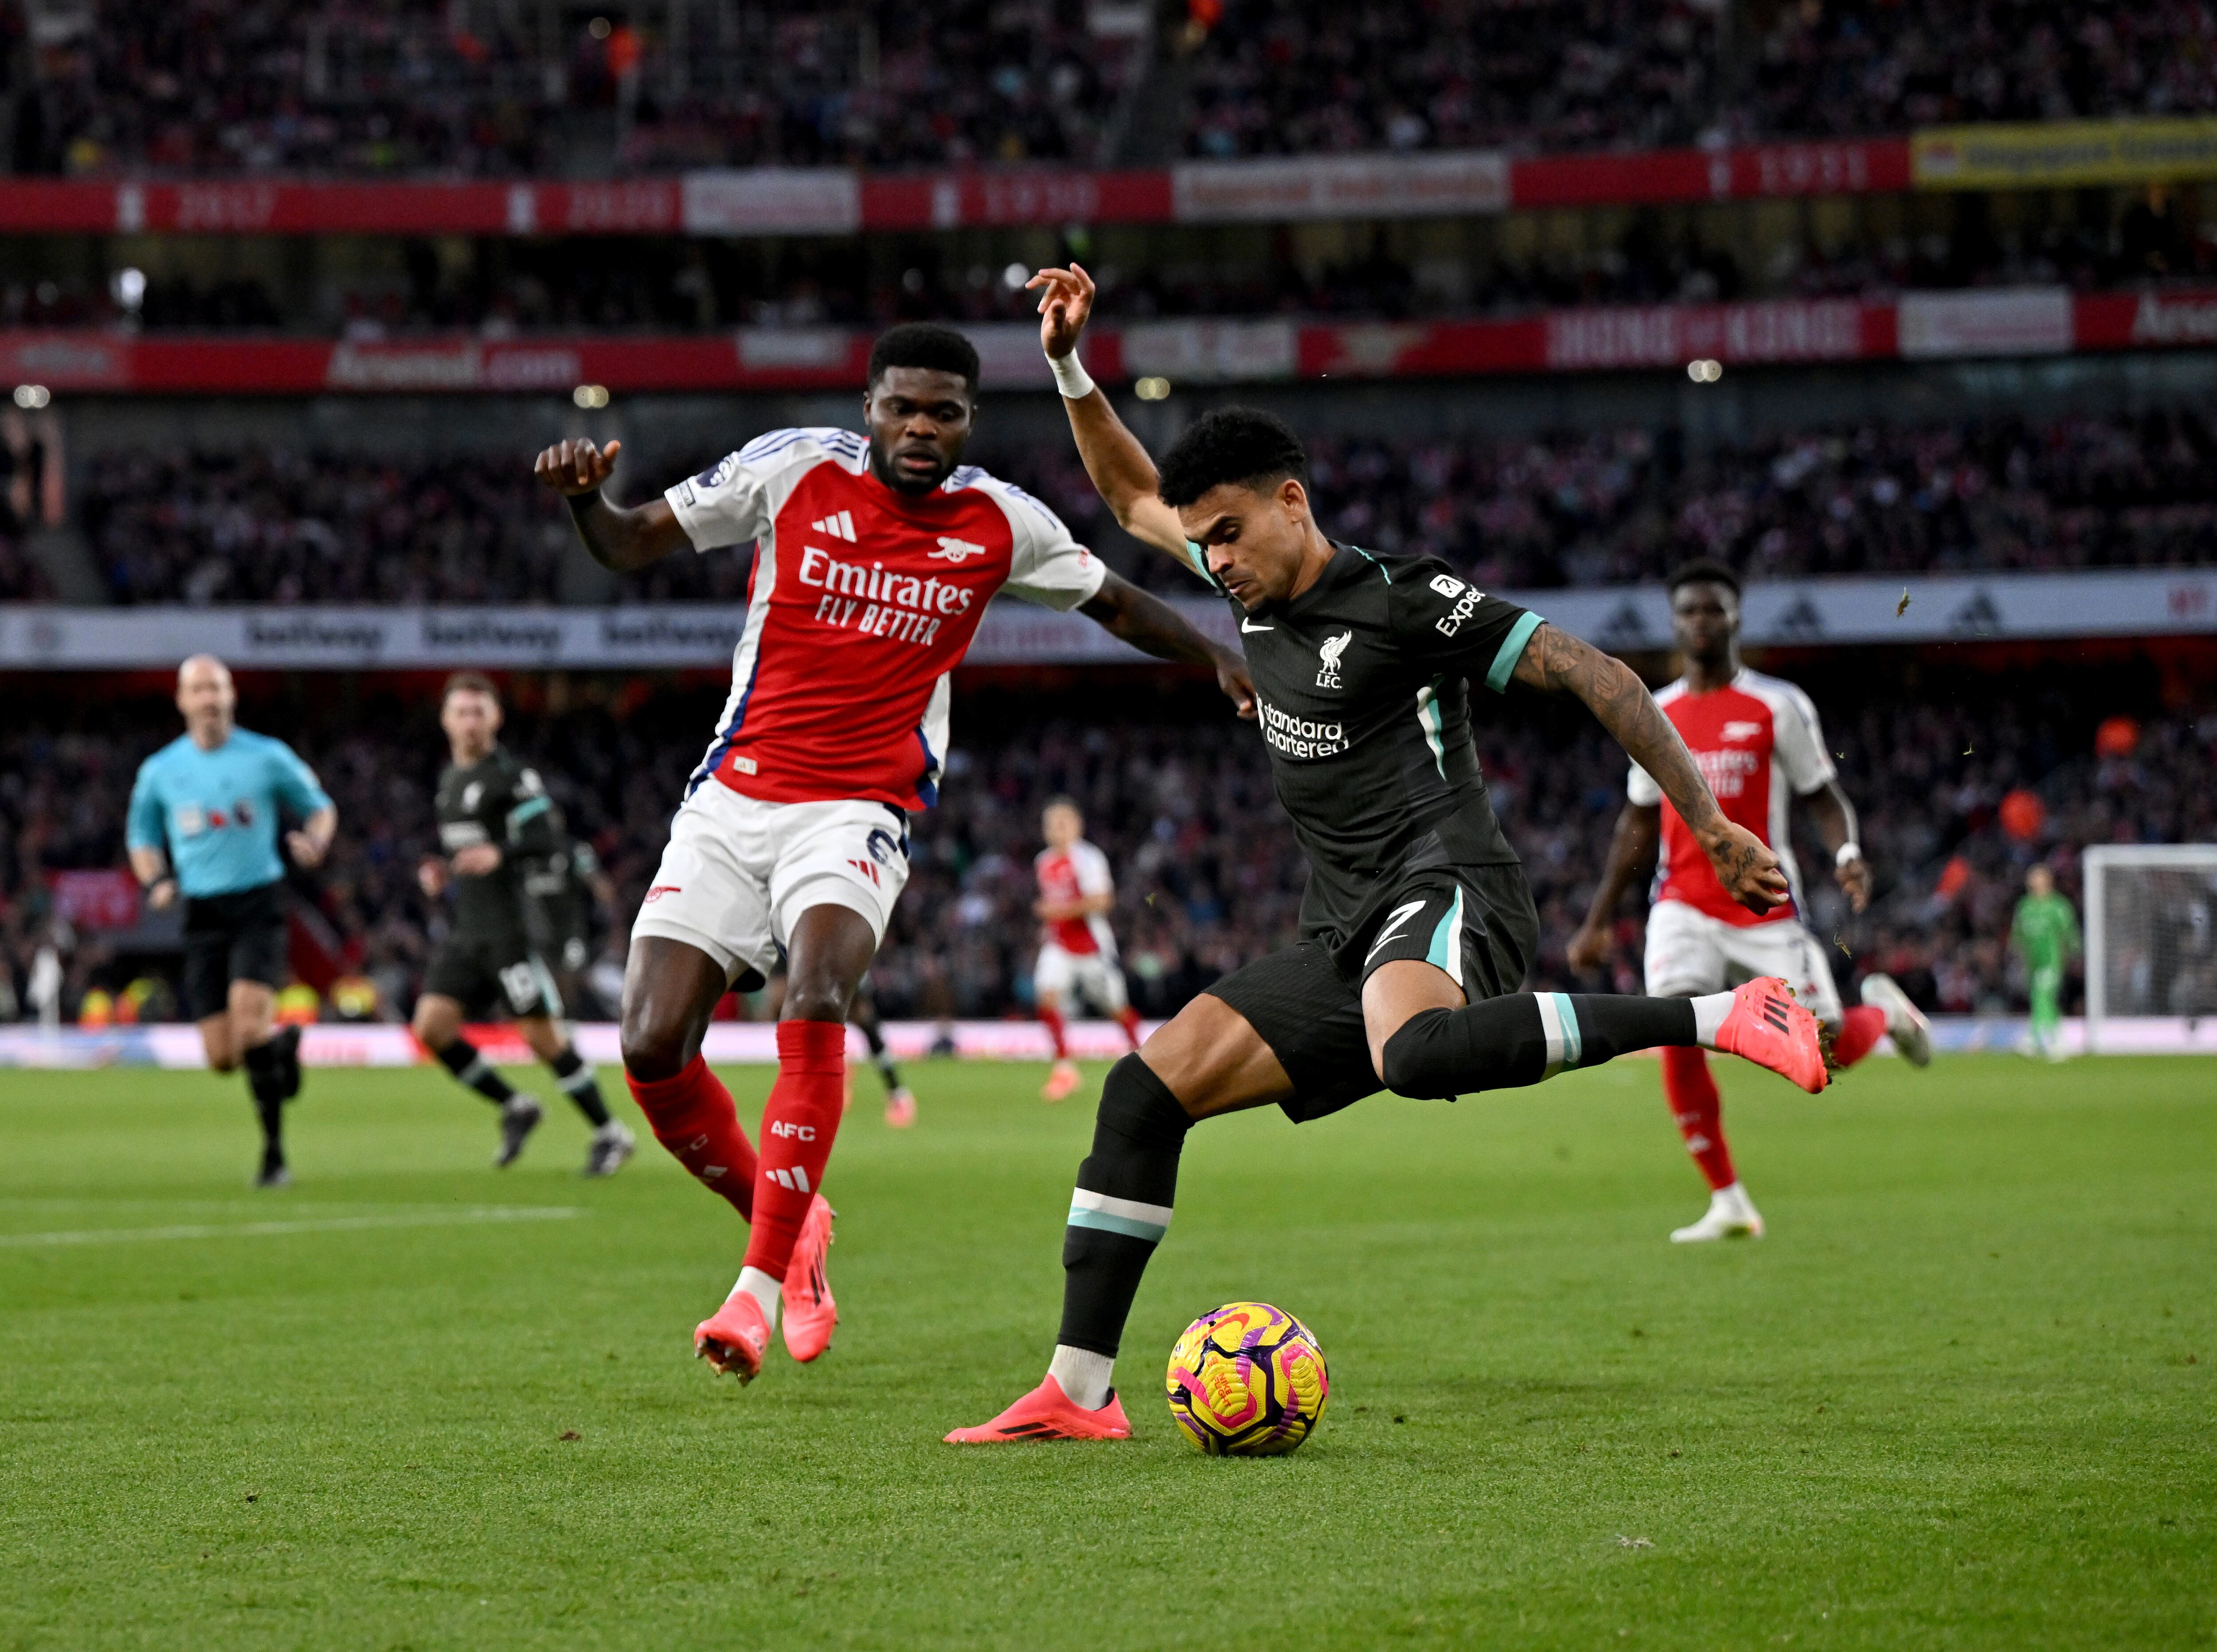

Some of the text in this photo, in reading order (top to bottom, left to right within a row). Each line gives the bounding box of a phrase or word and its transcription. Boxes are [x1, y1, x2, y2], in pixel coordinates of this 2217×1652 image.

[799, 545, 974, 615] Emirates
[815, 594, 858, 628] FLY
[858, 603, 942, 646] BETTER
[1375, 900, 1427, 946] 7
[771, 1120, 816, 1142] AFC
[1213, 1376, 1232, 1407] FLIGHT
[1218, 1372, 1233, 1396] NIKE
